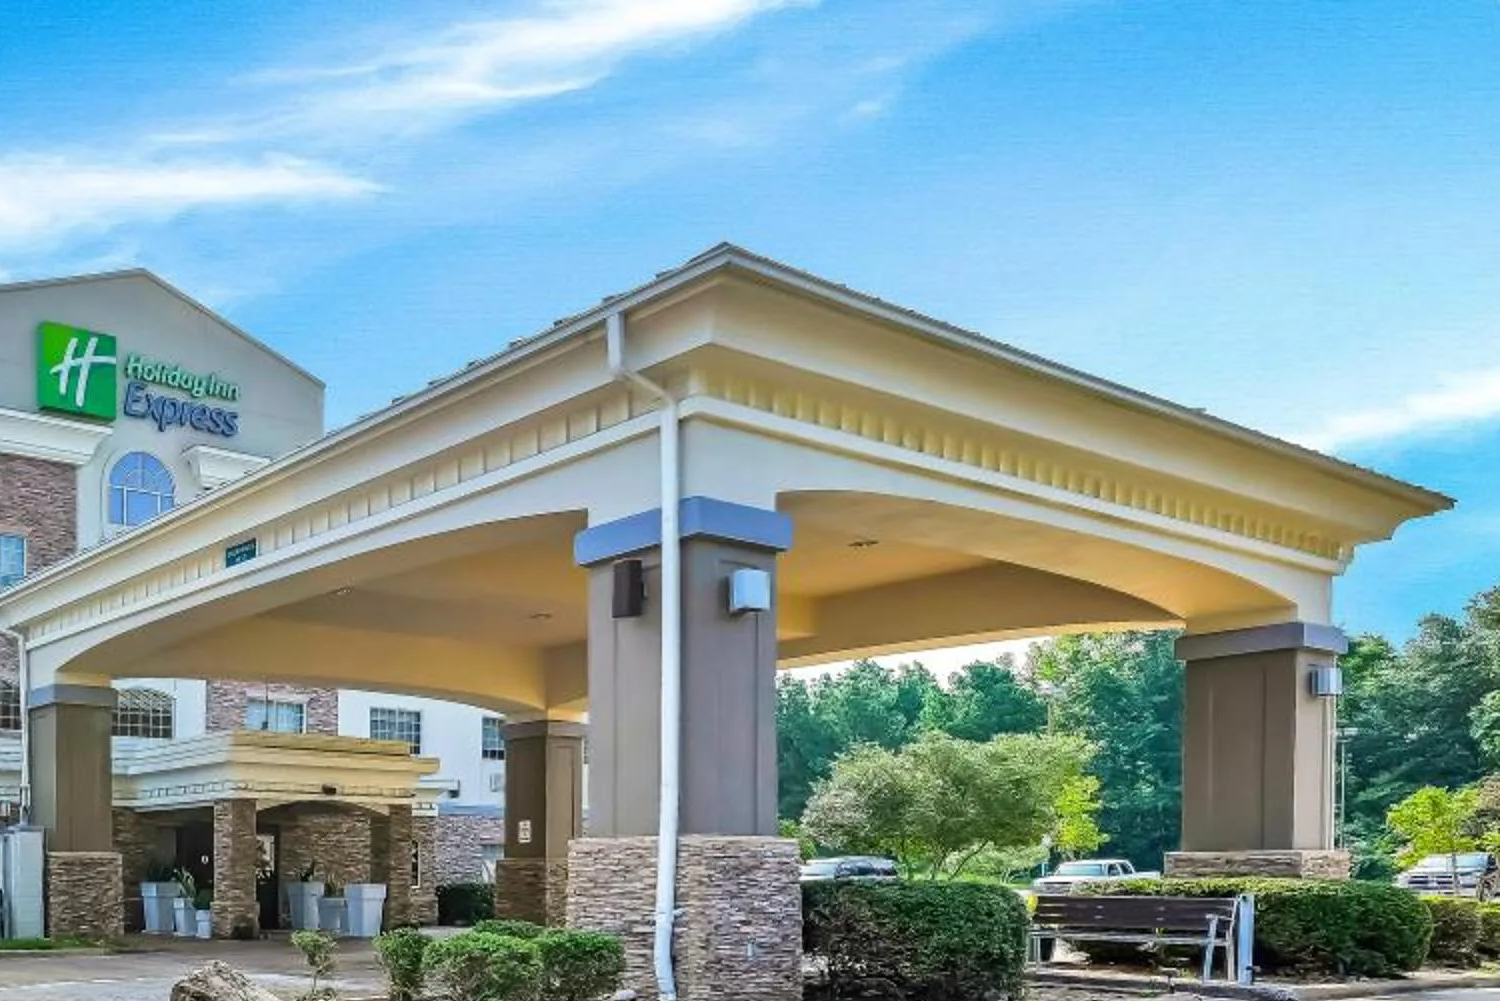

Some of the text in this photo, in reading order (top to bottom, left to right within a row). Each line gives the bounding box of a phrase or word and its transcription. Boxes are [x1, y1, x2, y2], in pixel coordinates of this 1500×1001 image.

[125, 353, 240, 401] Holiday Inn
[124, 381, 239, 437] Express
